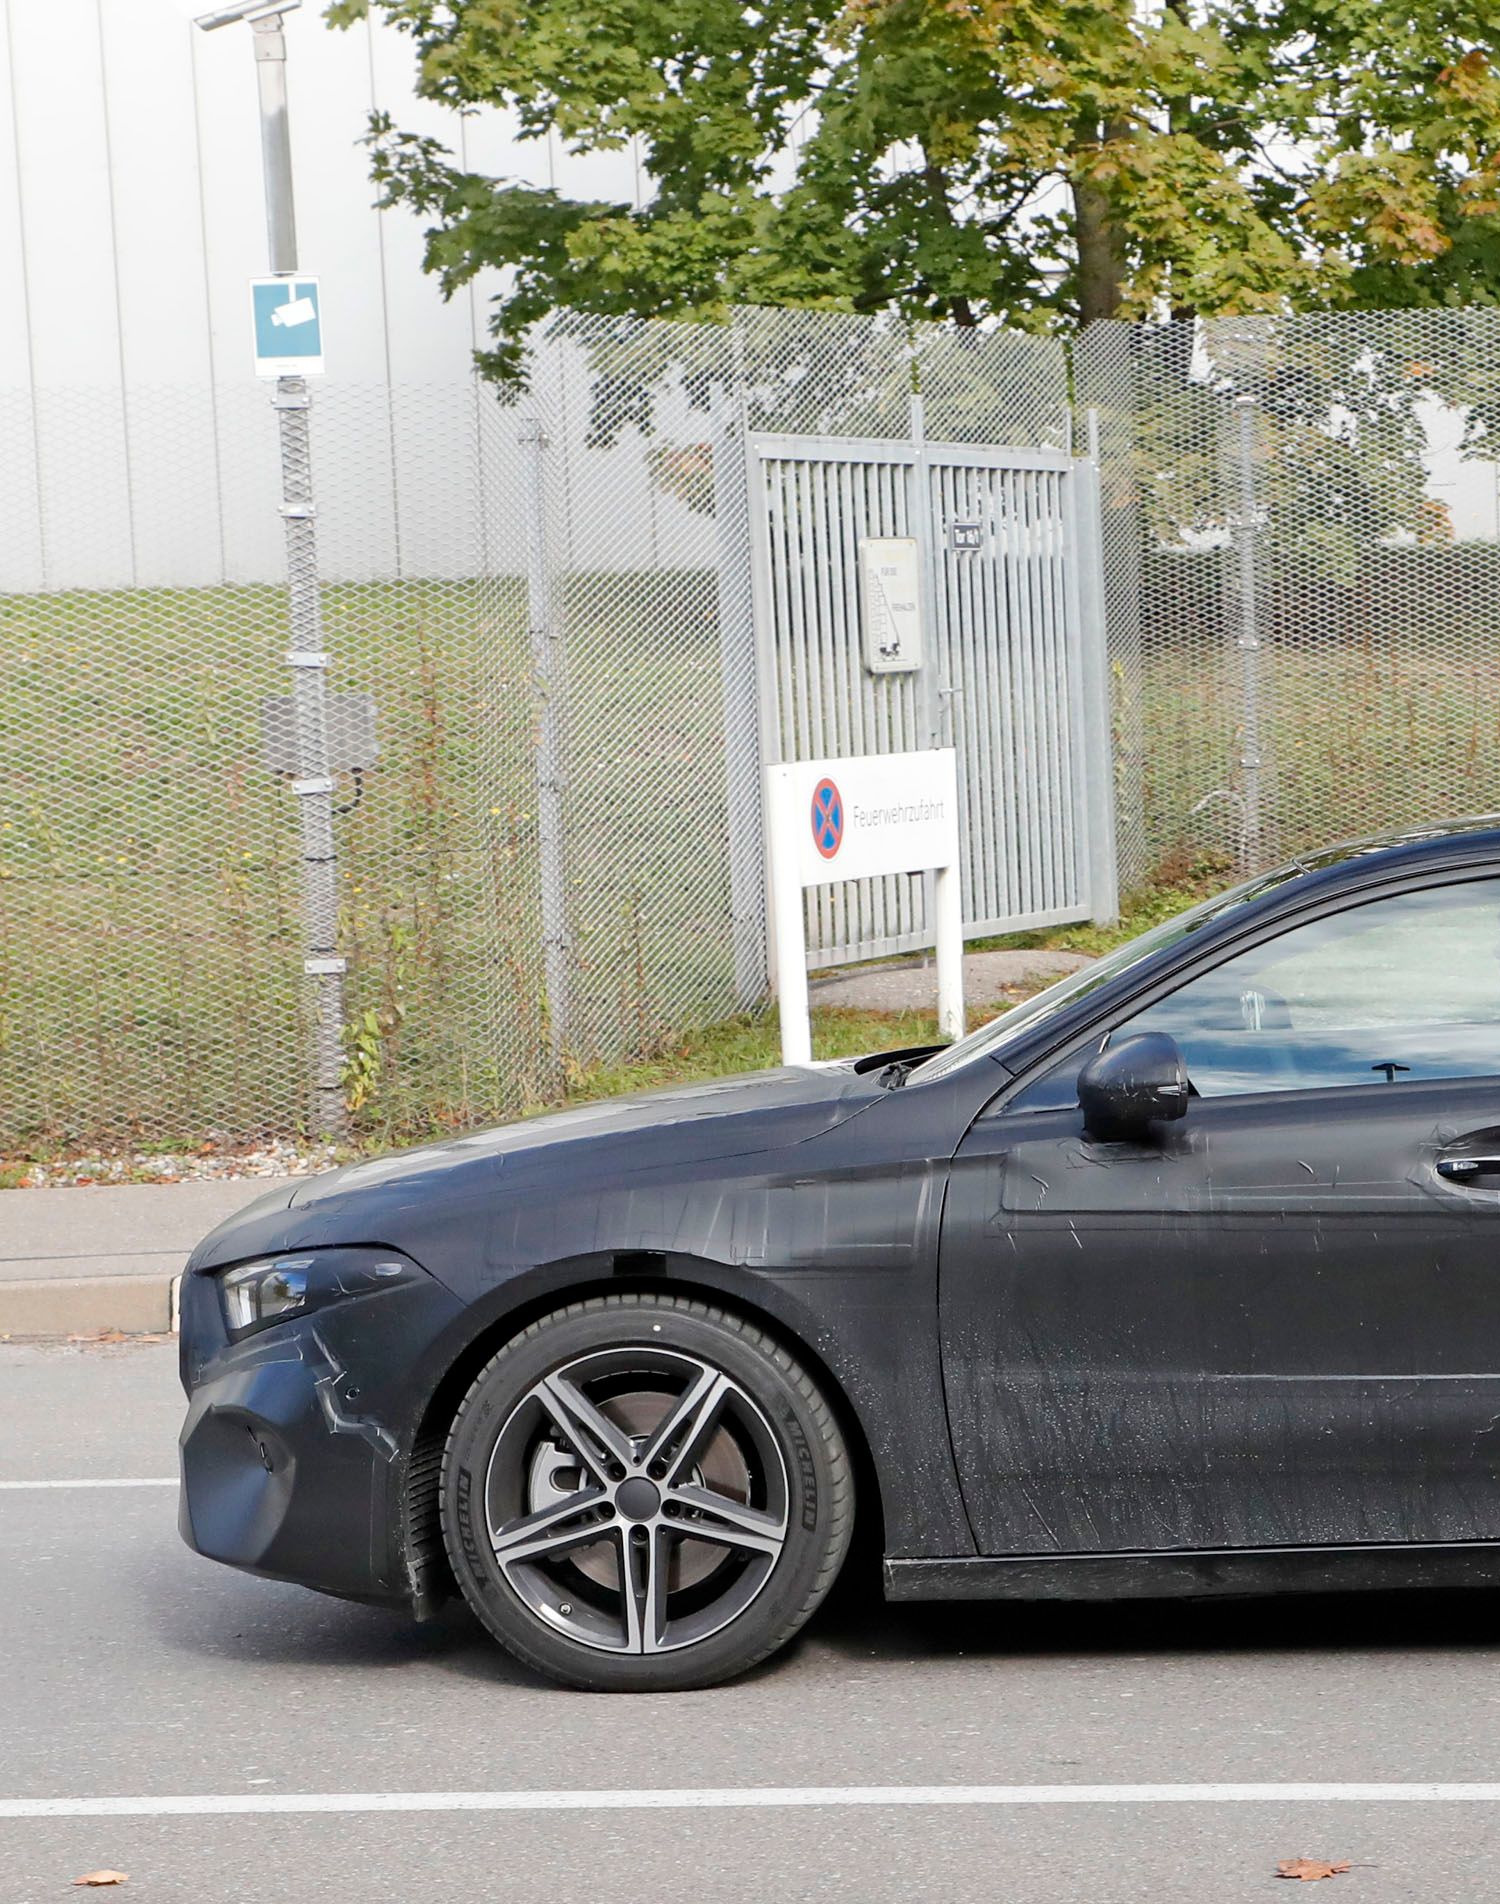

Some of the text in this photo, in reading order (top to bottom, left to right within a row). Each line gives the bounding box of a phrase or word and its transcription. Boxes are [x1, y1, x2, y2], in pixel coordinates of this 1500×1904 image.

[853, 799, 944, 828] Feuerwehrzufahrt
[458, 1469, 486, 1581] MICHELIN
[784, 1418, 817, 1528] MICHELIN
